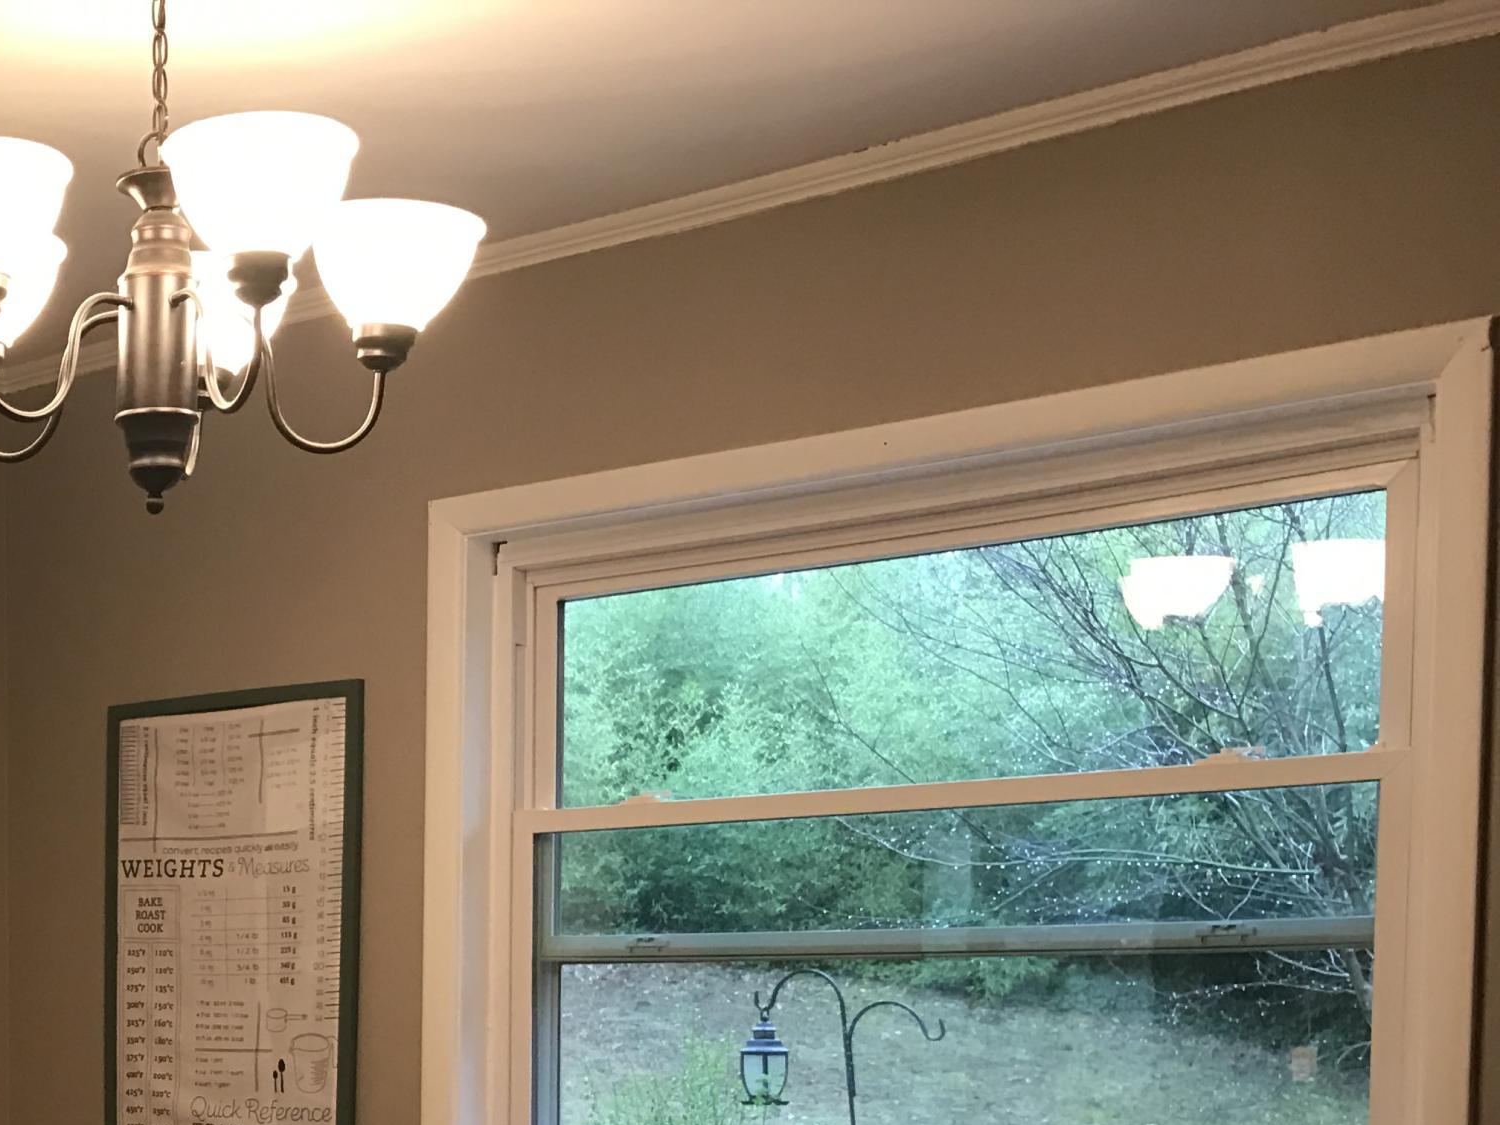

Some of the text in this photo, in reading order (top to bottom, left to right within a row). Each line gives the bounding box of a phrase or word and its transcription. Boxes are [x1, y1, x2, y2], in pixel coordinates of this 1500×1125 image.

[234, 842, 262, 854] quickly
[121, 858, 224, 878] WEIGHTS
[238, 856, 311, 878] Measures
[137, 896, 164, 907] BAKE
[135, 910, 166, 920] ROAST
[137, 924, 164, 933] COOK
[190, 1095, 333, 1124] Quick Reference
